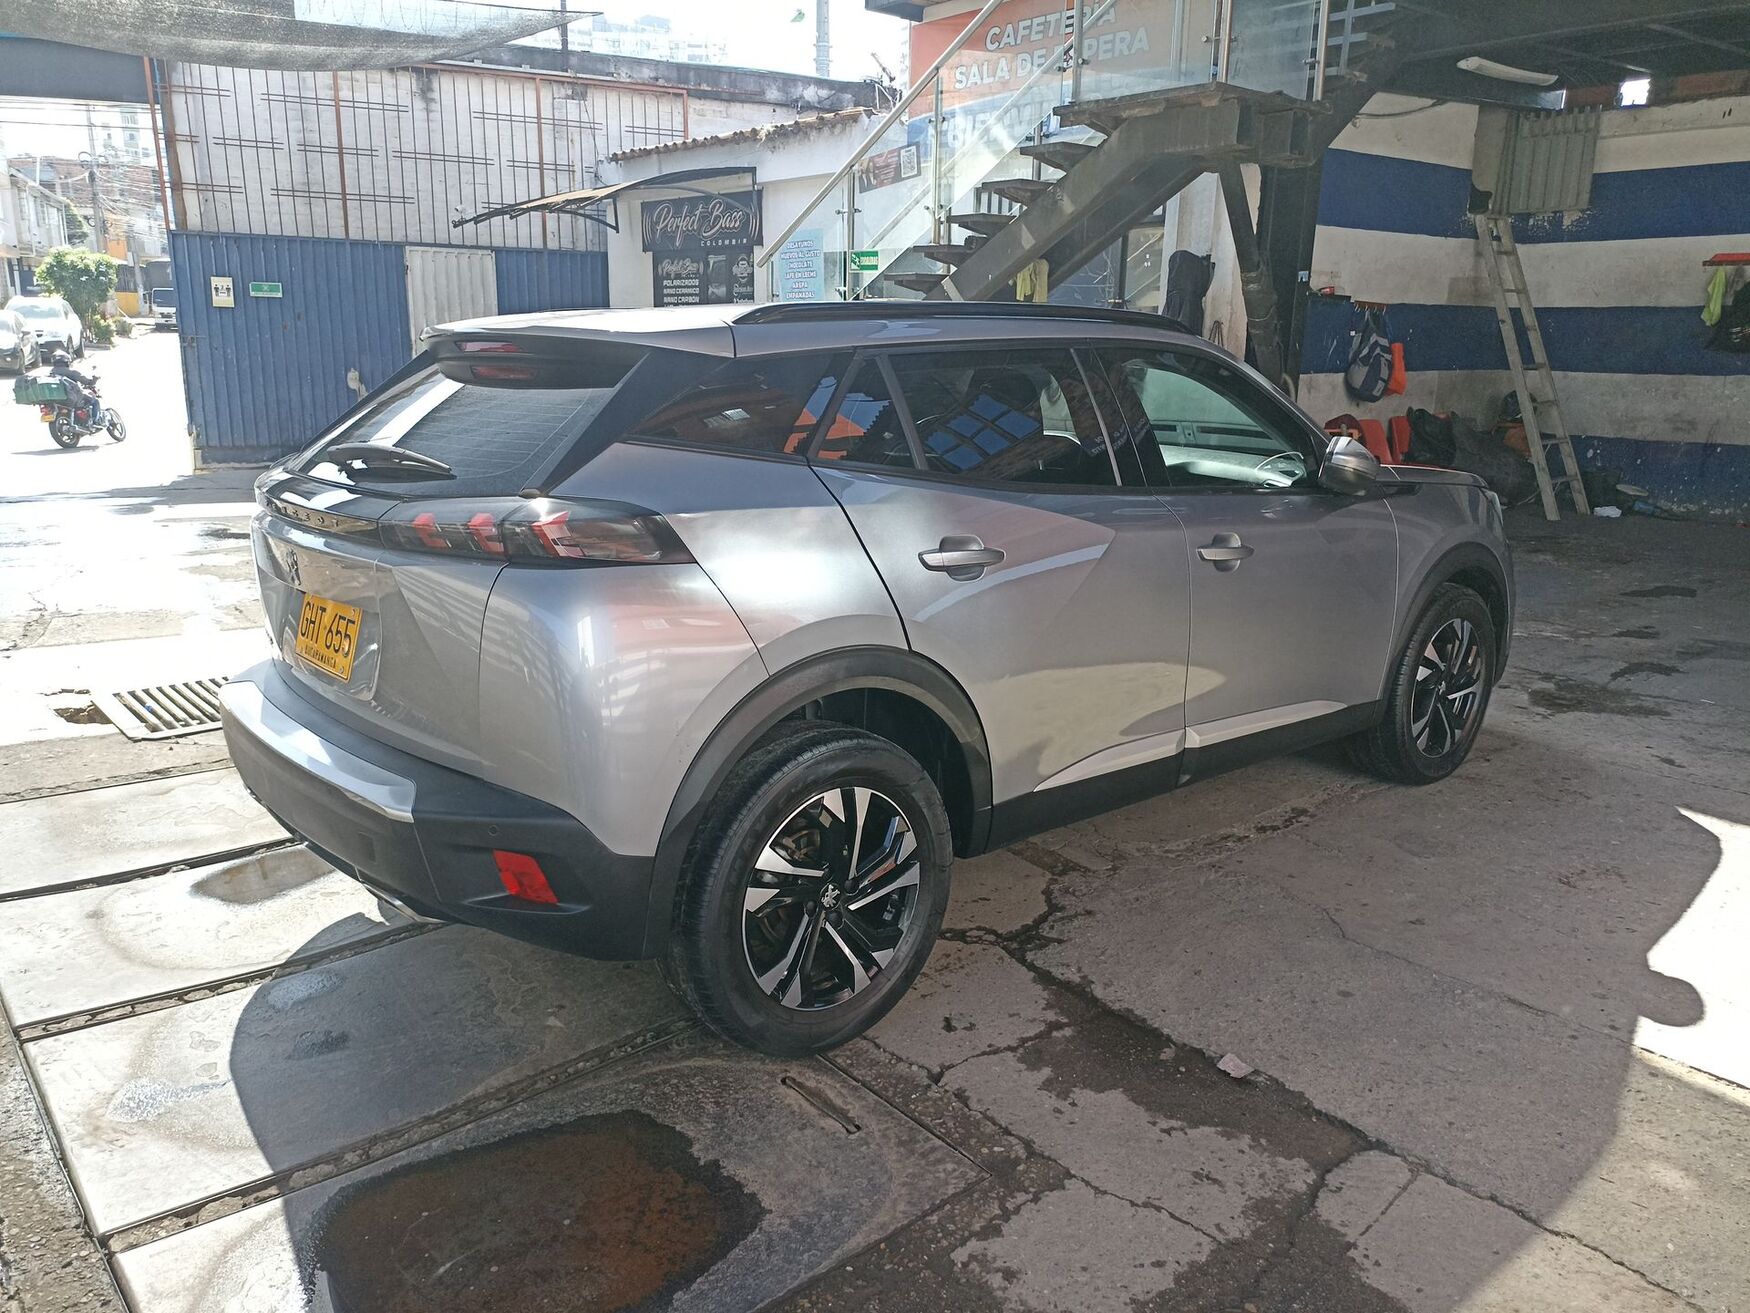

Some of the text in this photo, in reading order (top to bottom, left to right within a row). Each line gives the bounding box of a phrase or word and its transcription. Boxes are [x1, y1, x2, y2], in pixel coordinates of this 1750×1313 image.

[953, 57, 1010, 90] SALA
[1015, 48, 1046, 76] DE
[653, 198, 744, 248] Perfect Bass
[700, 238, 747, 247] COLOMBIA
[663, 279, 699, 287] POLARIZADOS
[300, 600, 356, 658] GHT 655
